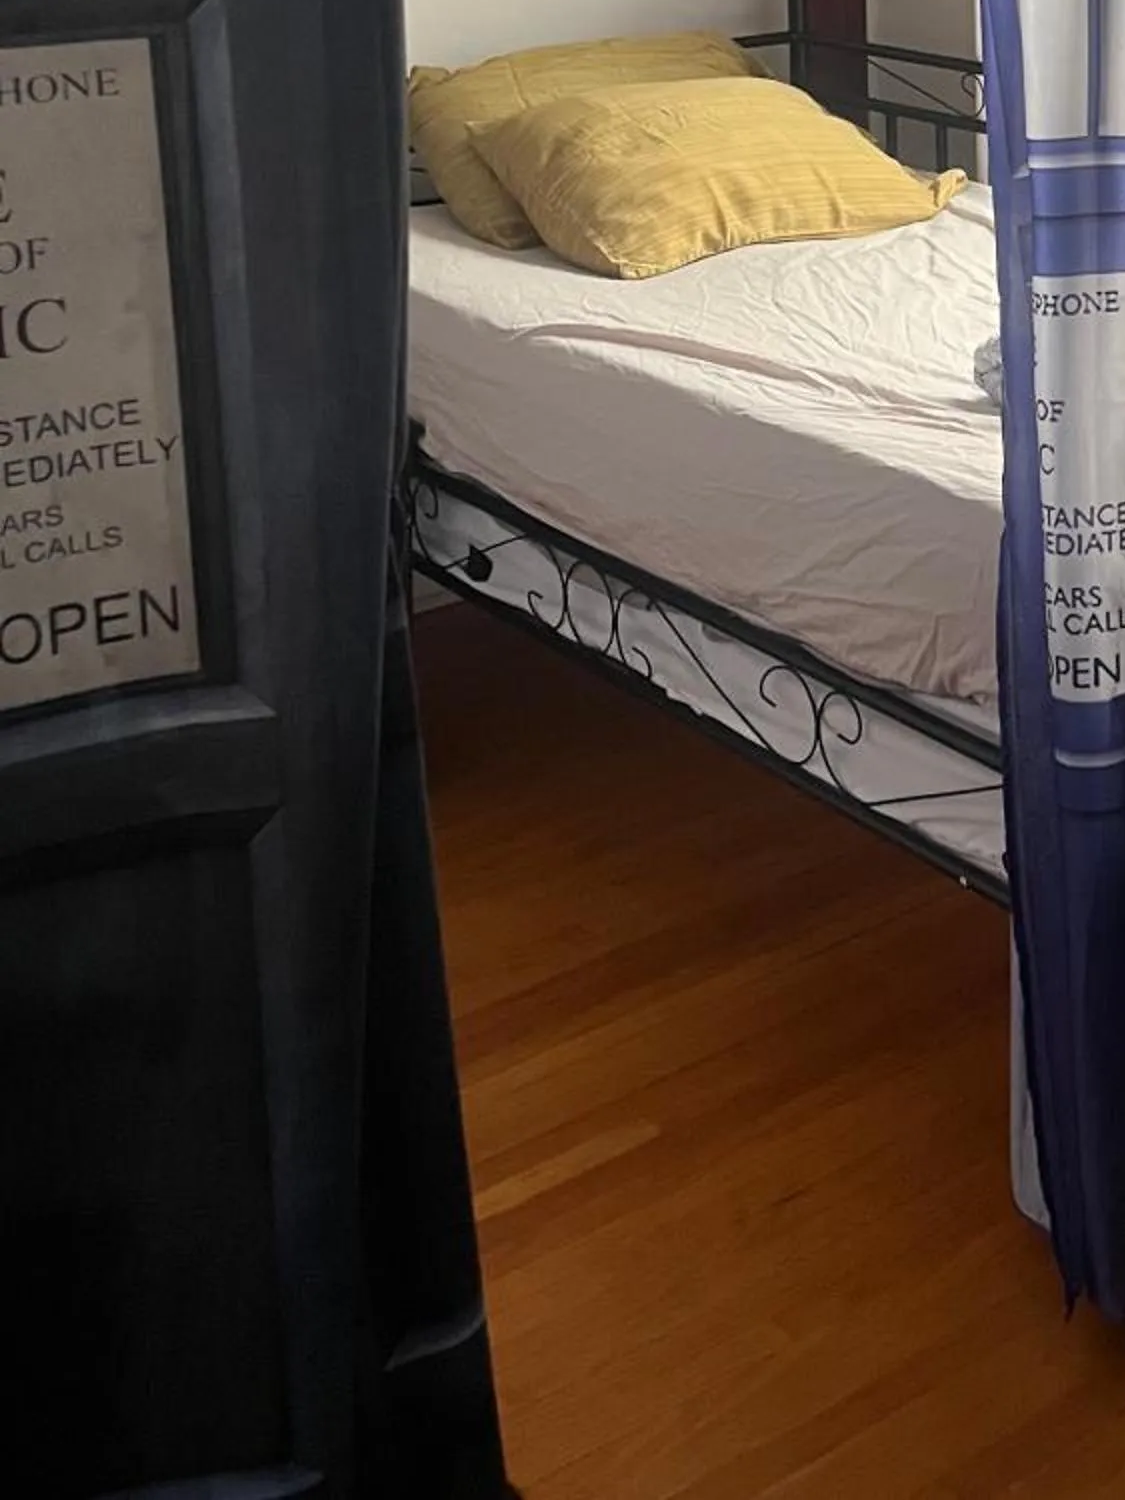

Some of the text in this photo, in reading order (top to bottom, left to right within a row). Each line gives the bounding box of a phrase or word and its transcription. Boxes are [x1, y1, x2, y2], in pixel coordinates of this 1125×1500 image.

[3, 435, 178, 488] EDIATELY
[25, 526, 124, 563] CALLS
[0, 585, 179, 665] OPEN
[1048, 653, 1121, 688] PEN
